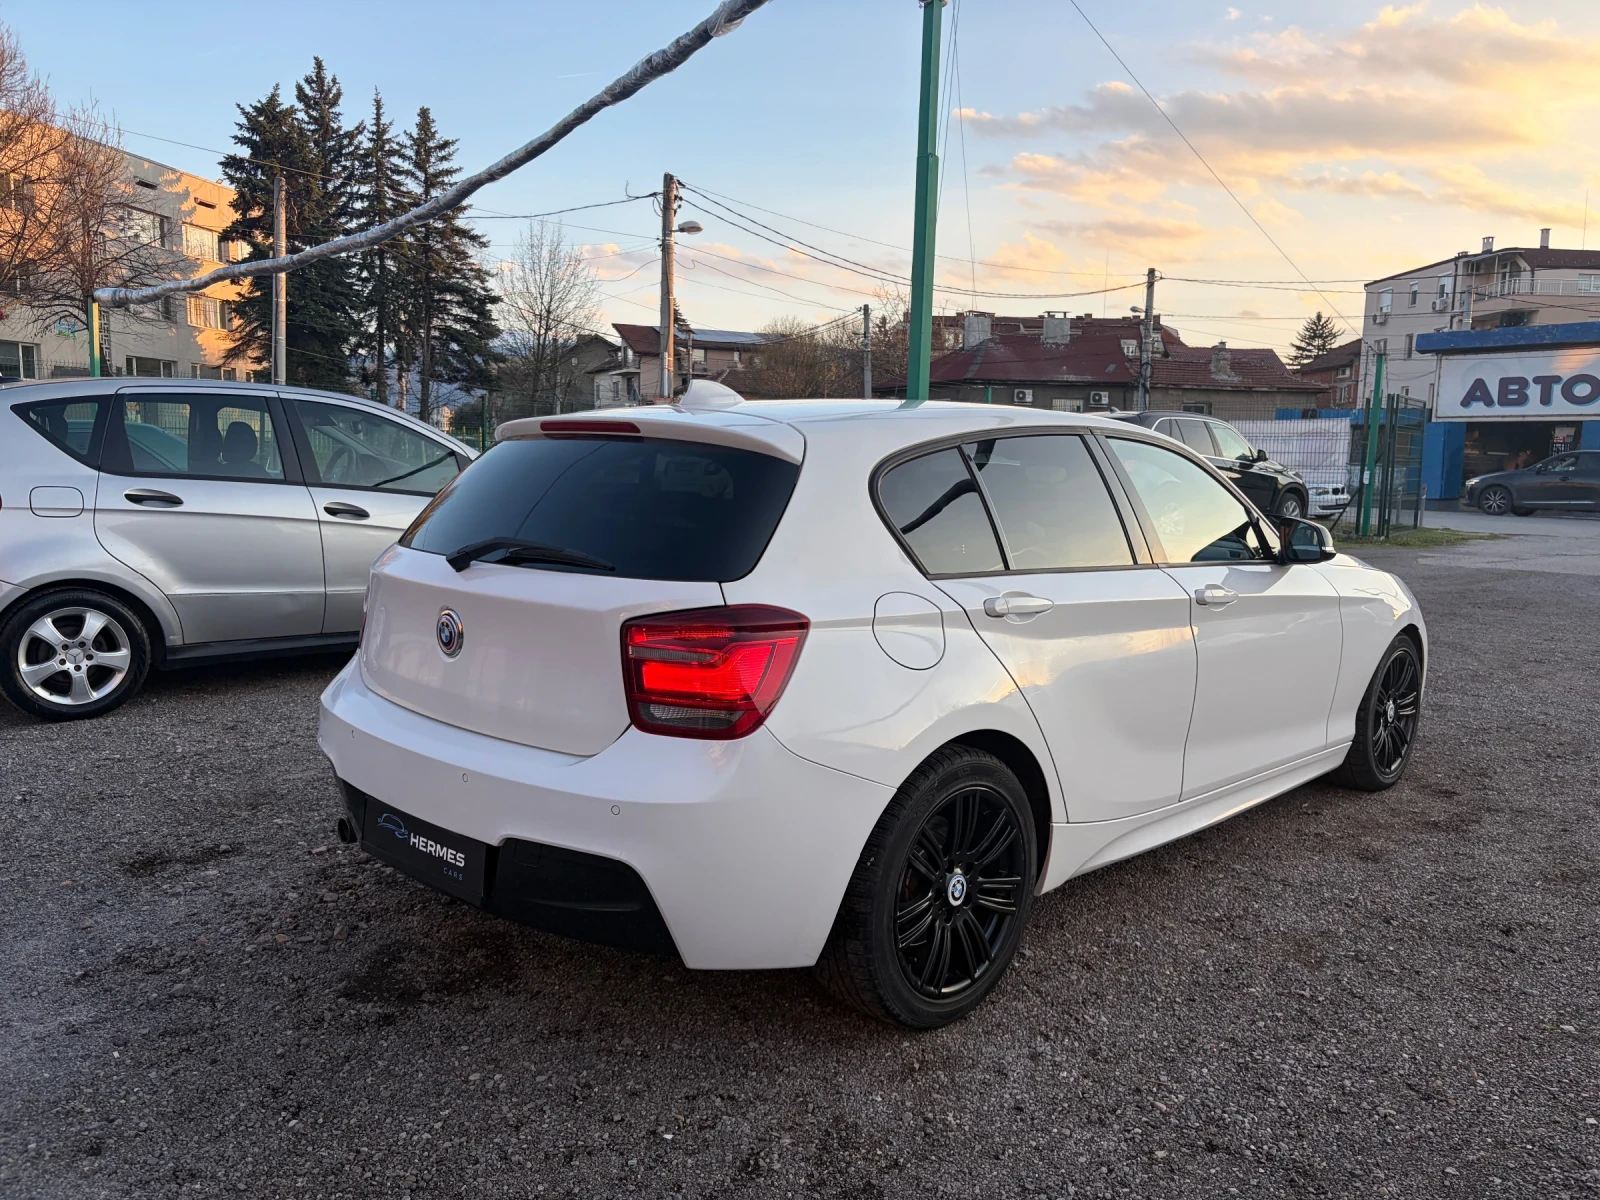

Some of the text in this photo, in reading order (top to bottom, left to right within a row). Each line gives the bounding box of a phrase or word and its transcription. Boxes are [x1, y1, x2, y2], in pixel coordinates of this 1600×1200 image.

[1460, 373, 1600, 408] АВТО
[410, 832, 465, 867] HERMES
[443, 867, 463, 881] CARS
